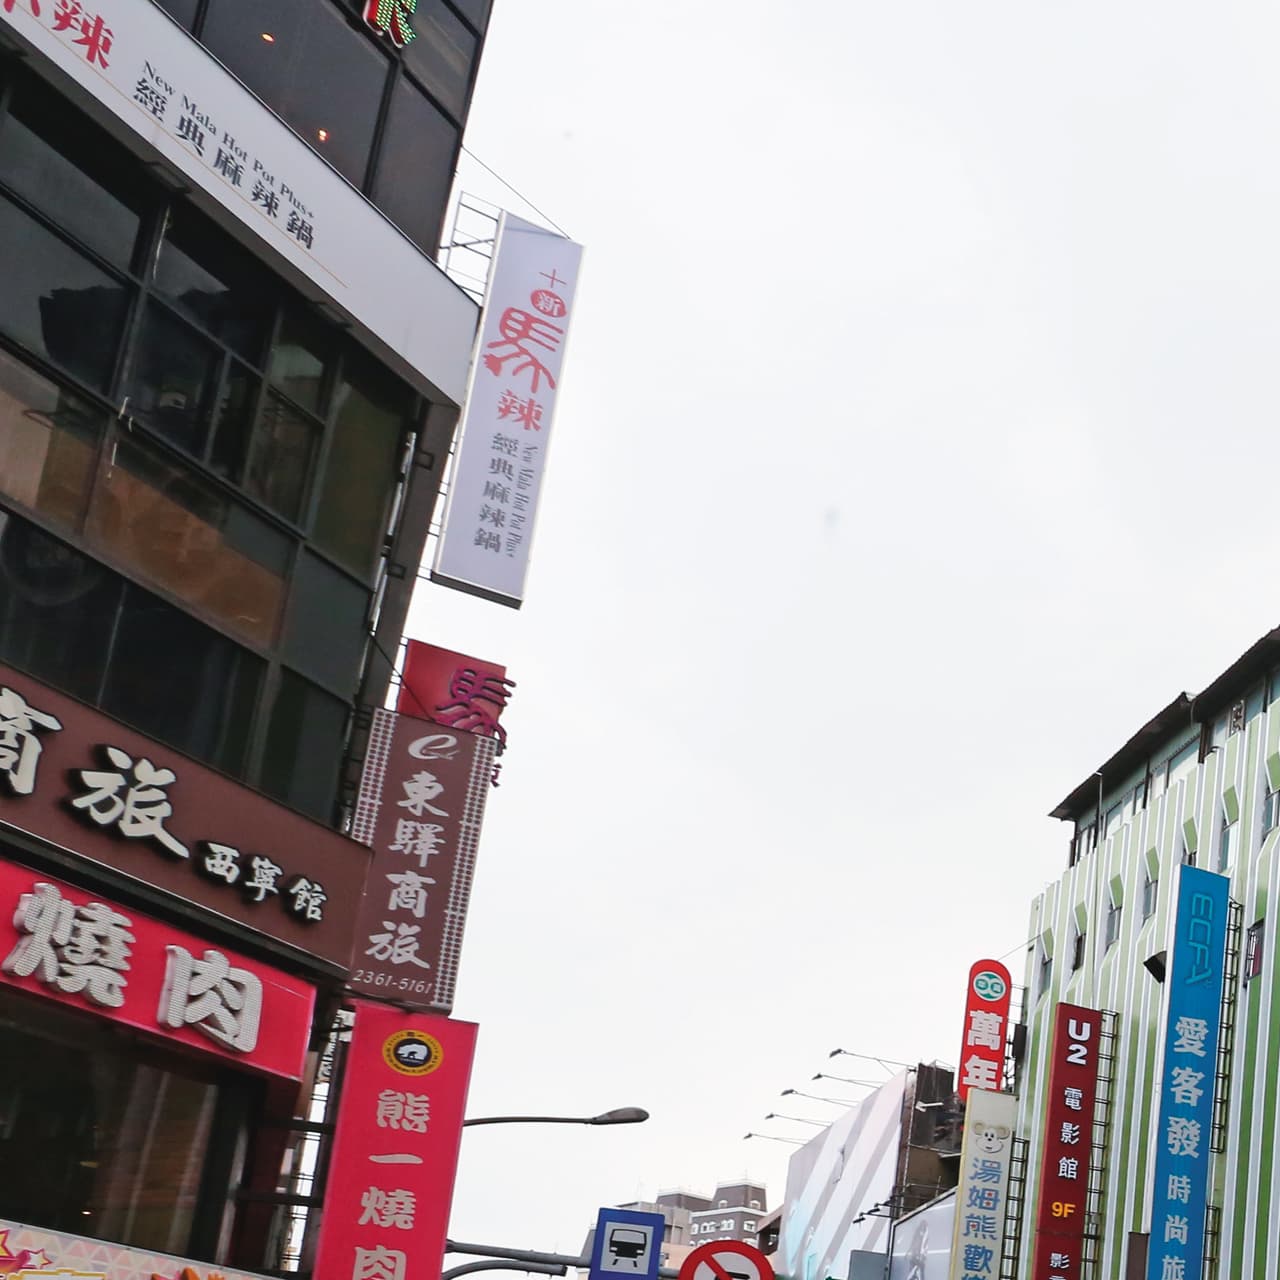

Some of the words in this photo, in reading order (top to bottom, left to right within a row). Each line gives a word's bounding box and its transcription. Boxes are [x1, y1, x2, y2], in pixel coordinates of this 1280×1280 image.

[133, 77, 315, 250] 經典麻辣鍋
[143, 60, 176, 97] New
[180, 95, 217, 134] Mala
[223, 131, 248, 163] Hot
[252, 160, 275, 187] Pot
[473, 432, 520, 553] 經典麻辣鍋
[205, 842, 328, 921] 西寧館
[364, 771, 449, 969] 東驛商旅
[2, 882, 263, 1053] 燒肉
[352, 969, 433, 995] 2361-5161
[962, 1010, 1003, 1090] 萬年
[1066, 1019, 1091, 1067] U2
[1167, 1016, 1209, 1159] 愛客發
[1057, 1087, 1083, 1180] 電影館
[1051, 1201, 1076, 1219] 9F
